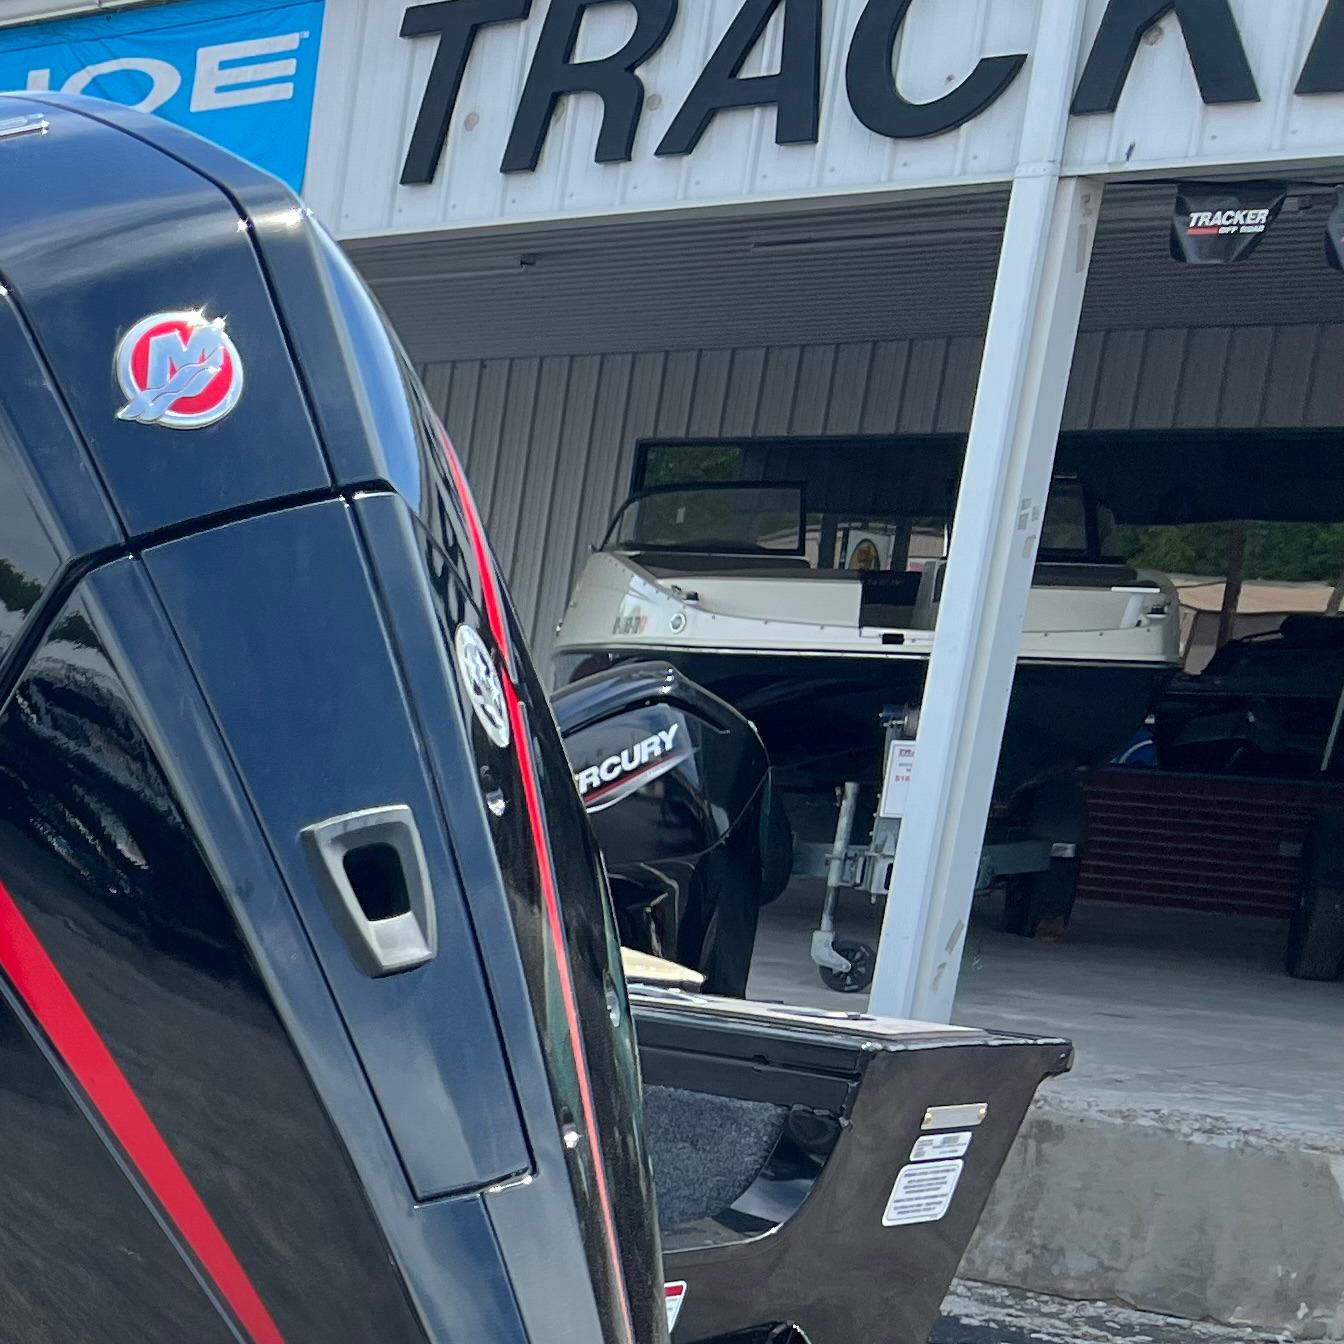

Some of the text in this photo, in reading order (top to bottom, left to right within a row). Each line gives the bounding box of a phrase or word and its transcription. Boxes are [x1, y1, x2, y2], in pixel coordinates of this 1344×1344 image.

[399, 0, 1344, 185] TRACK
[1188, 208, 1270, 228] TRACKER
[574, 723, 679, 794] RCURY
